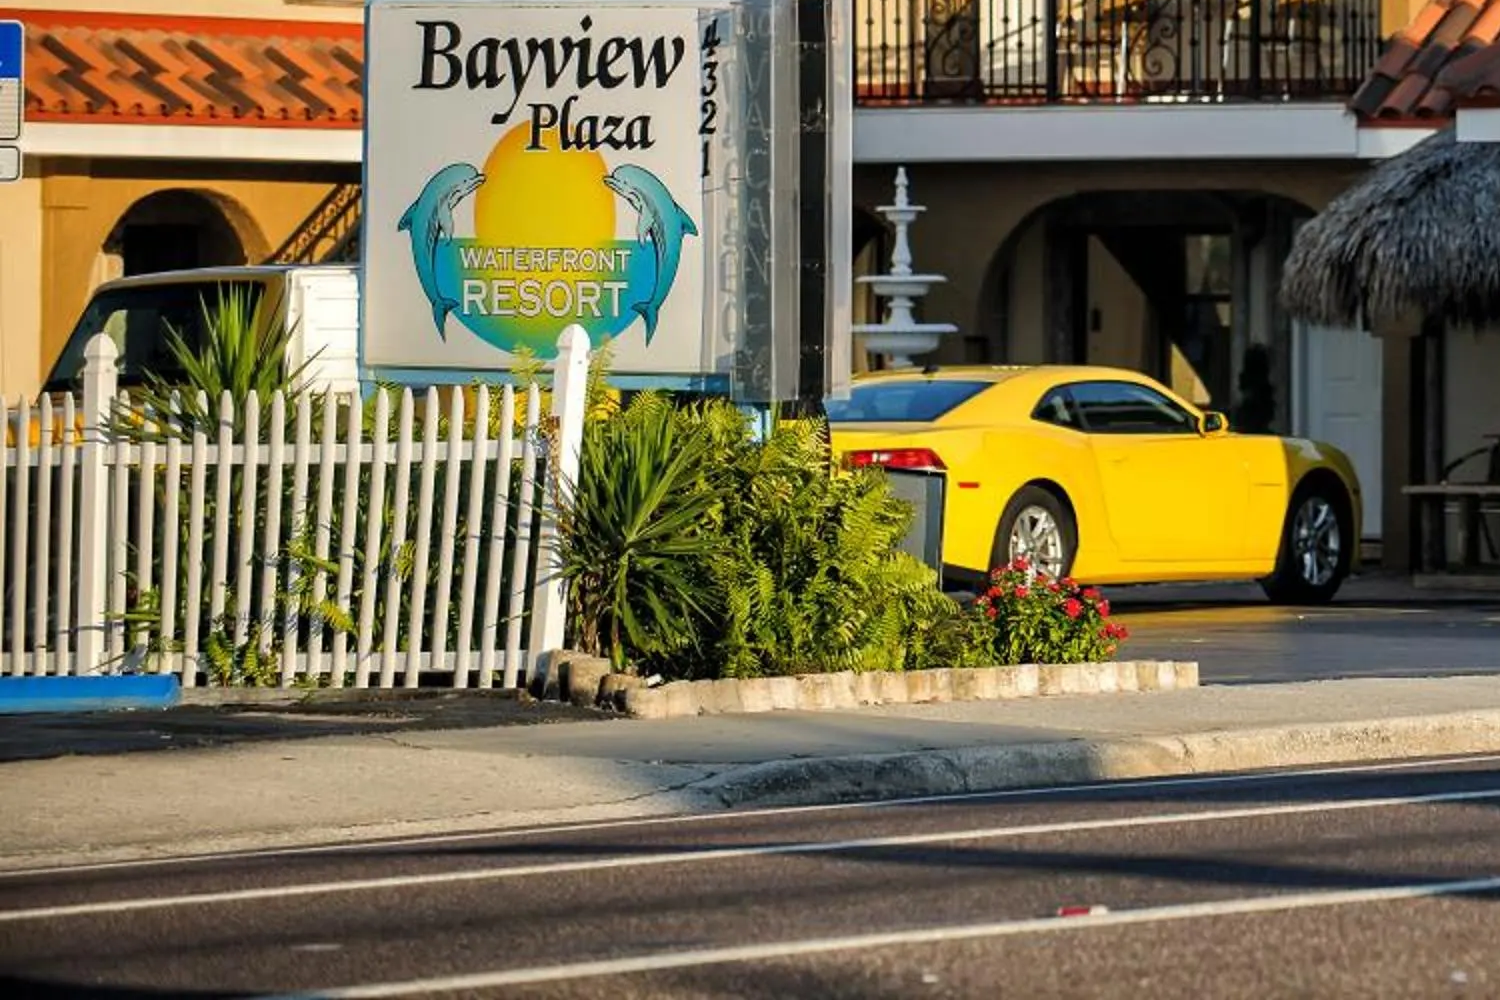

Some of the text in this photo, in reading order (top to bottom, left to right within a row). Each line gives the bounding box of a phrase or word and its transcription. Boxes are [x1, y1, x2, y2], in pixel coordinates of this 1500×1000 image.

[412, 15, 685, 124] Bayview
[525, 95, 655, 151] Plaza
[698, 18, 721, 178] 4321
[459, 247, 633, 273] WATERFRONT
[462, 279, 629, 318] RESORT
